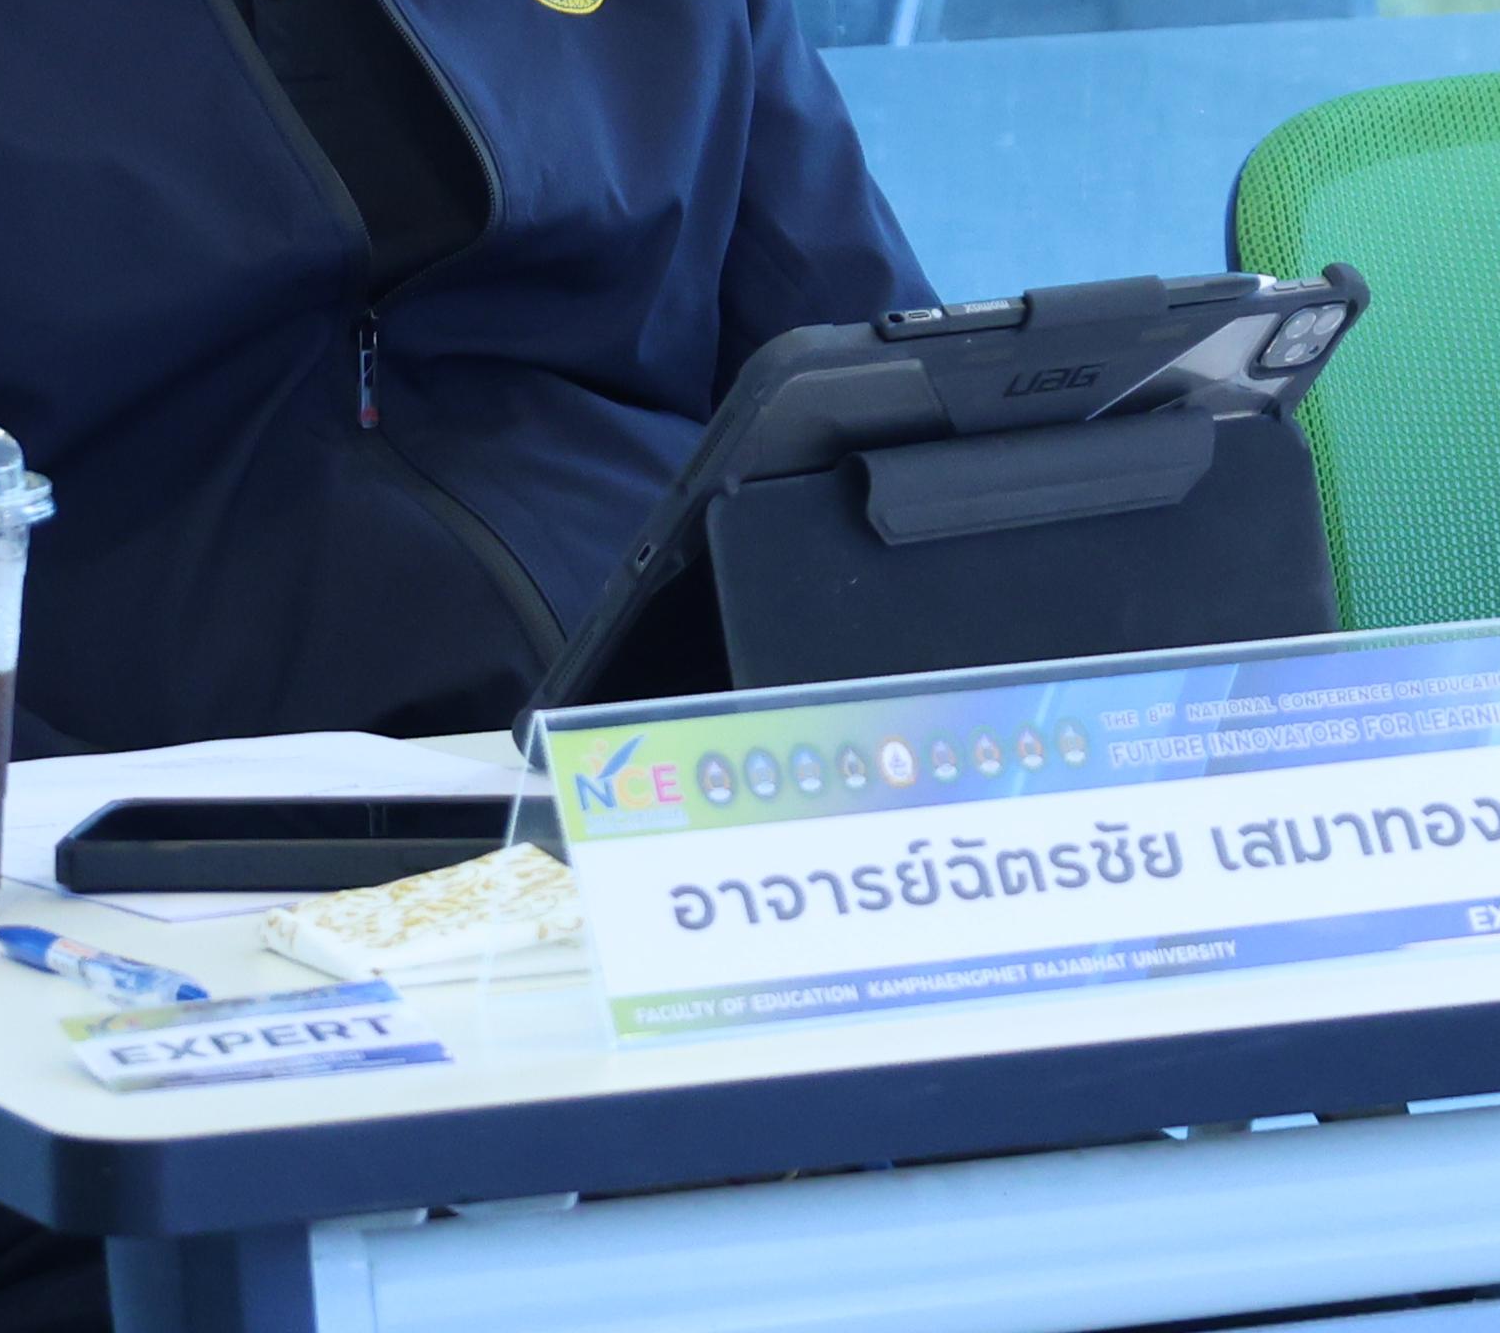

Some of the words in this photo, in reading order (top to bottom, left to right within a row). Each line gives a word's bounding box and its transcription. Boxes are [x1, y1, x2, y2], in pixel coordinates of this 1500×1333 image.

[1104, 711, 1139, 729] THE
[1188, 695, 1276, 721] NATIONAL
[1278, 684, 1392, 711] CONFERENCE
[1396, 681, 1422, 698] ON
[1110, 736, 1202, 767] FUTURE
[1210, 719, 1359, 755] INNOVATORS
[1363, 712, 1413, 737] FOR
[668, 822, 1183, 933] อาจารย์ฉัตรชัย
[636, 999, 715, 1024] FACULTY
[722, 996, 745, 1015] OF
[751, 983, 859, 1013] EDUCATION
[867, 964, 1027, 999] KAMPHAENGPHET
[1033, 953, 1129, 979] RAJABHAT
[1134, 940, 1237, 969] UNIVERSITY
[109, 1015, 393, 1067] EXPERT
